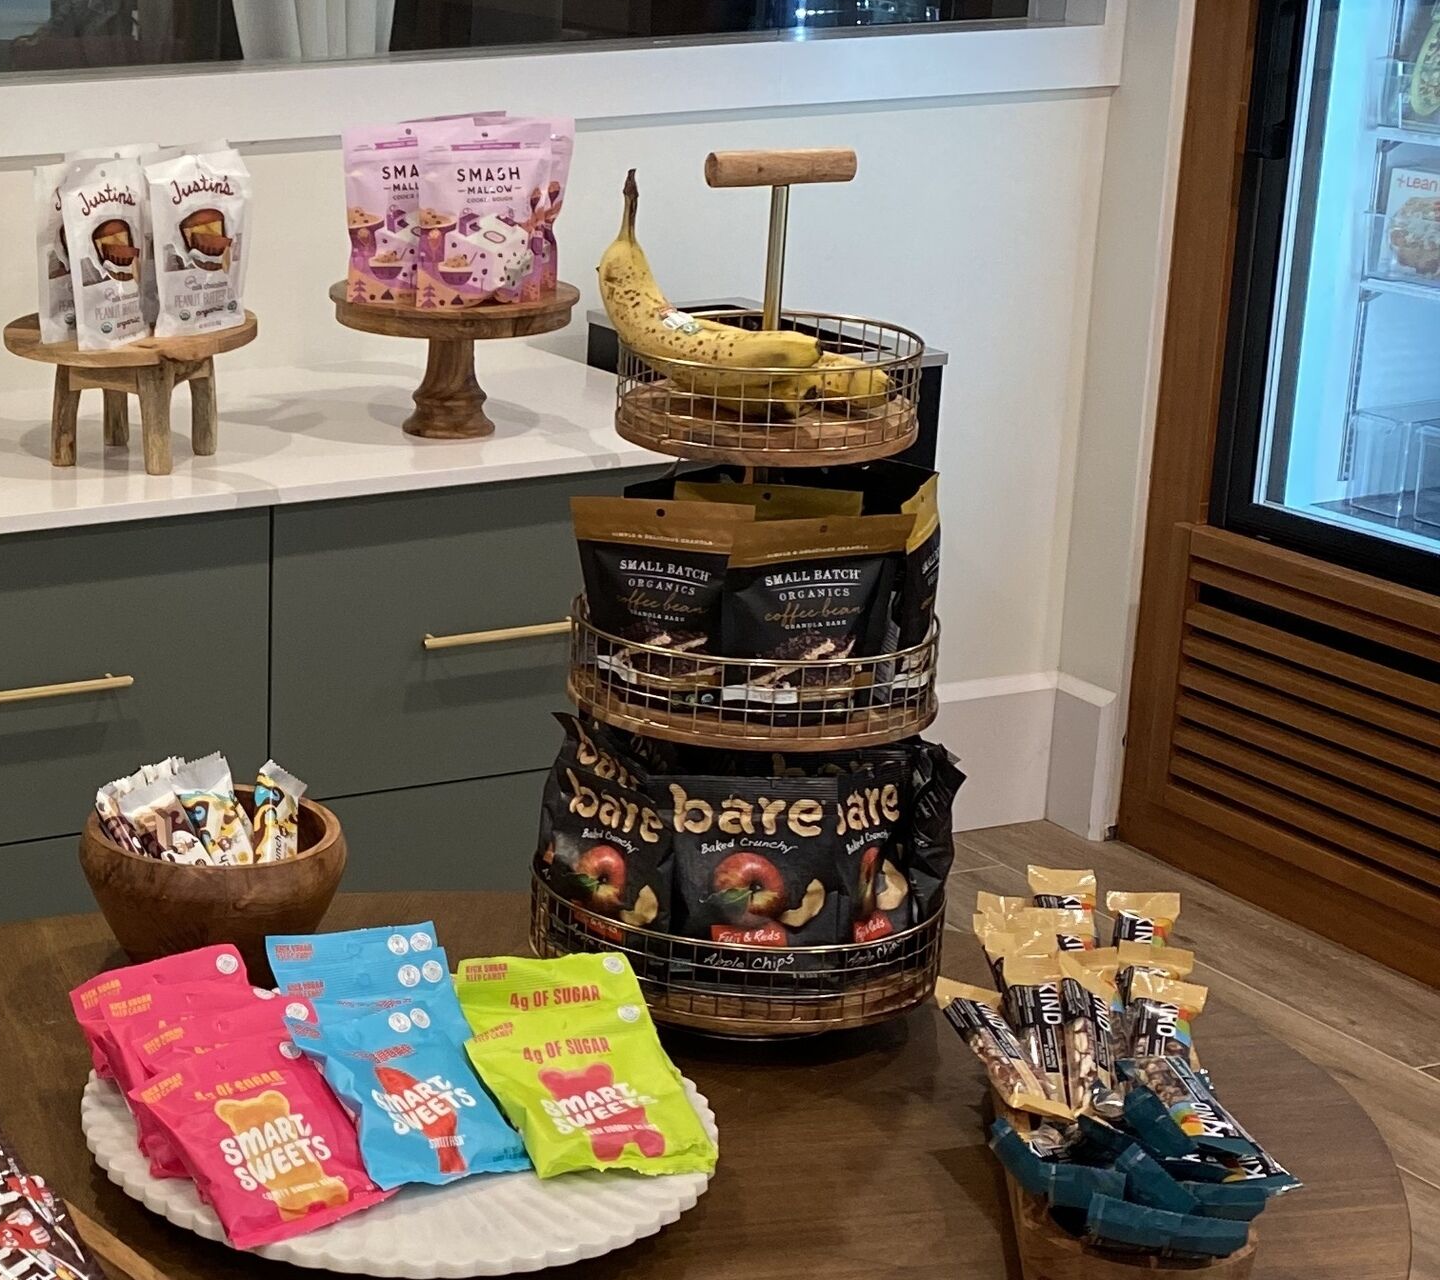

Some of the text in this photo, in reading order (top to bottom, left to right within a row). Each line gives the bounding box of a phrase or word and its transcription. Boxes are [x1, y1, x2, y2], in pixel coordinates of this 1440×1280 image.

[170, 174, 234, 205] Justin's
[457, 167, 520, 183] SMASH
[1406, 176, 1438, 193] Lean
[78, 184, 136, 216] Justin's
[619, 559, 711, 582] SMALL BATCH
[764, 568, 861, 587] SMALL BATCH
[628, 578, 696, 596] ORGANICS
[779, 587, 850, 601] ORGANICS
[764, 597, 864, 627] coffee bean
[565, 767, 664, 843] bare
[668, 782, 825, 838] bare
[701, 836, 799, 855] Baked Crunchy
[717, 928, 782, 946] Fuji Reds
[751, 950, 796, 972] Chips
[483, 972, 507, 982] CANDY
[510, 984, 601, 1011] 4g OF SUGAR
[1038, 981, 1062, 1026] KIND
[522, 1036, 612, 1064] 4g OF SUGAR
[371, 1075, 452, 1114] SMART
[540, 1082, 638, 1115] SMART
[388, 1087, 477, 1135] SWEETS
[552, 1095, 659, 1134] SWEETS
[220, 1113, 312, 1166] SMART
[234, 1136, 332, 1192] SWEETS
